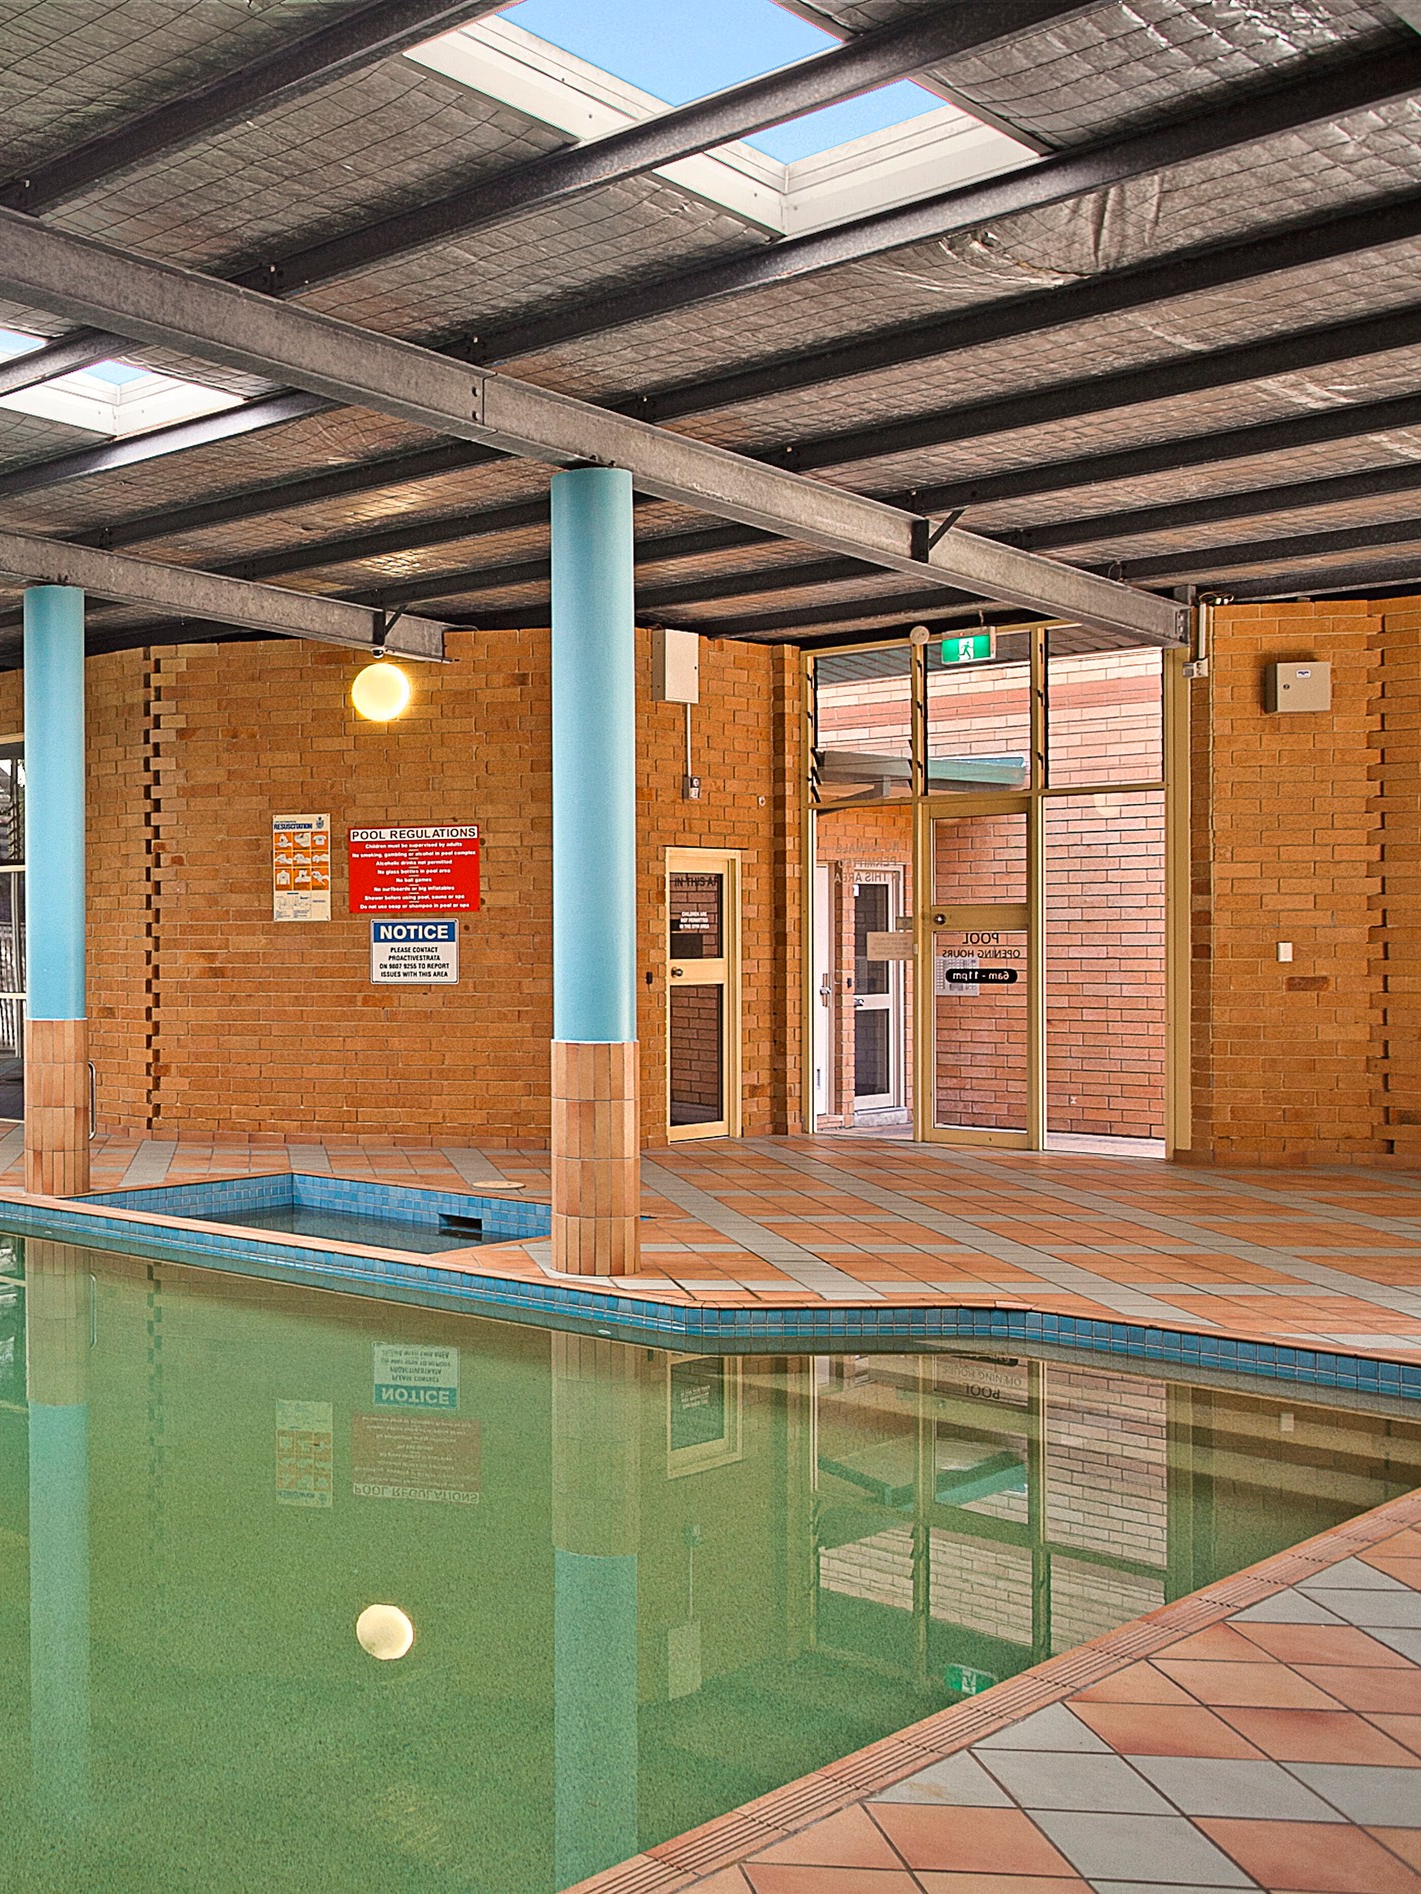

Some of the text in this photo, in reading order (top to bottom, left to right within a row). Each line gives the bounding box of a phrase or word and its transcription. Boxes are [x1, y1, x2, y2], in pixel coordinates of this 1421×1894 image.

[352, 828, 476, 840] POOL REGULATIONS
[380, 925, 449, 939] NOTICE
[963, 1383, 1000, 1399] POOL
